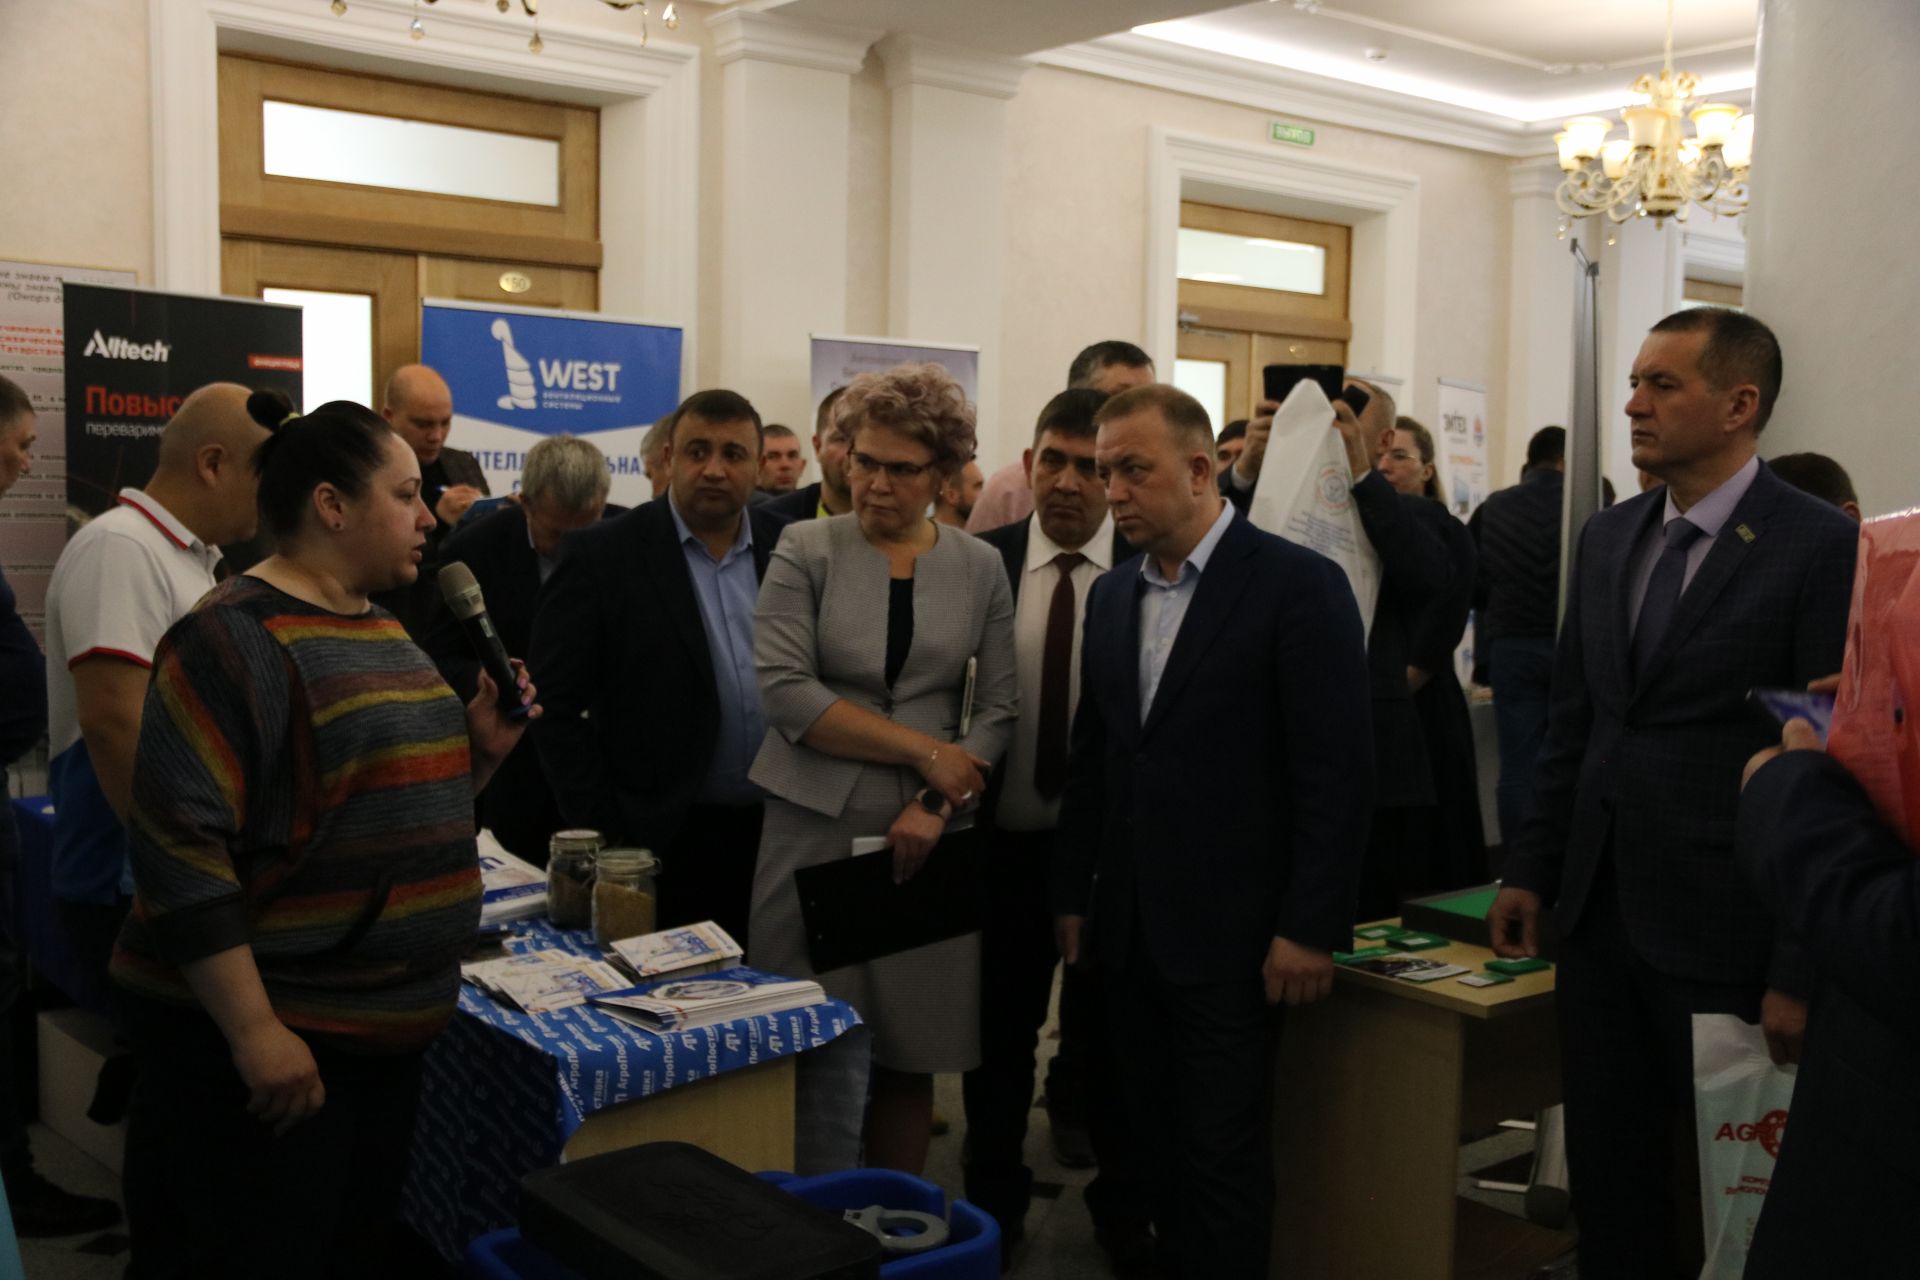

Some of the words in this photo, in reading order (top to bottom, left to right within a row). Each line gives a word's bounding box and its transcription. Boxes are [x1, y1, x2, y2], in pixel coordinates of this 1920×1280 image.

[83, 329, 170, 363] Alltech
[539, 358, 622, 392] WEST
[85, 384, 185, 418] Повыс
[85, 421, 164, 440] переварим
